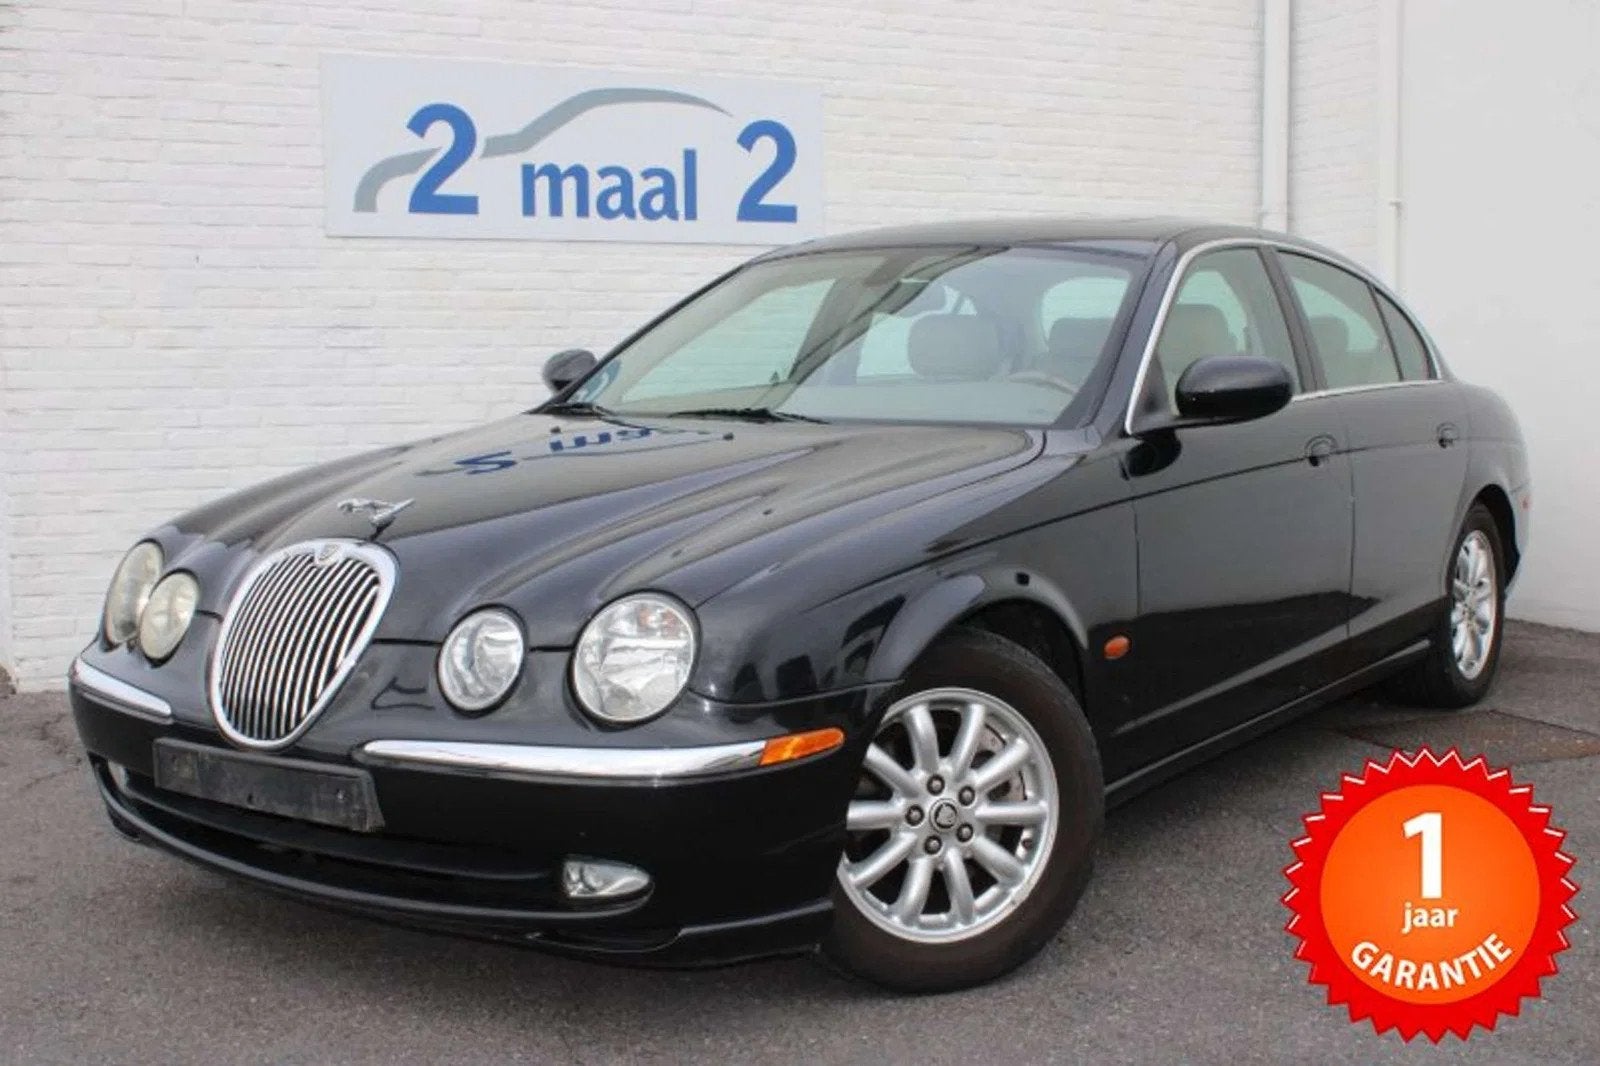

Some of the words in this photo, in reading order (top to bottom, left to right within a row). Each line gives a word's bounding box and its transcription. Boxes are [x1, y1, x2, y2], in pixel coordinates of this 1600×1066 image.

[406, 103, 479, 215] 2
[521, 148, 698, 221] maal
[736, 119, 798, 223] 2
